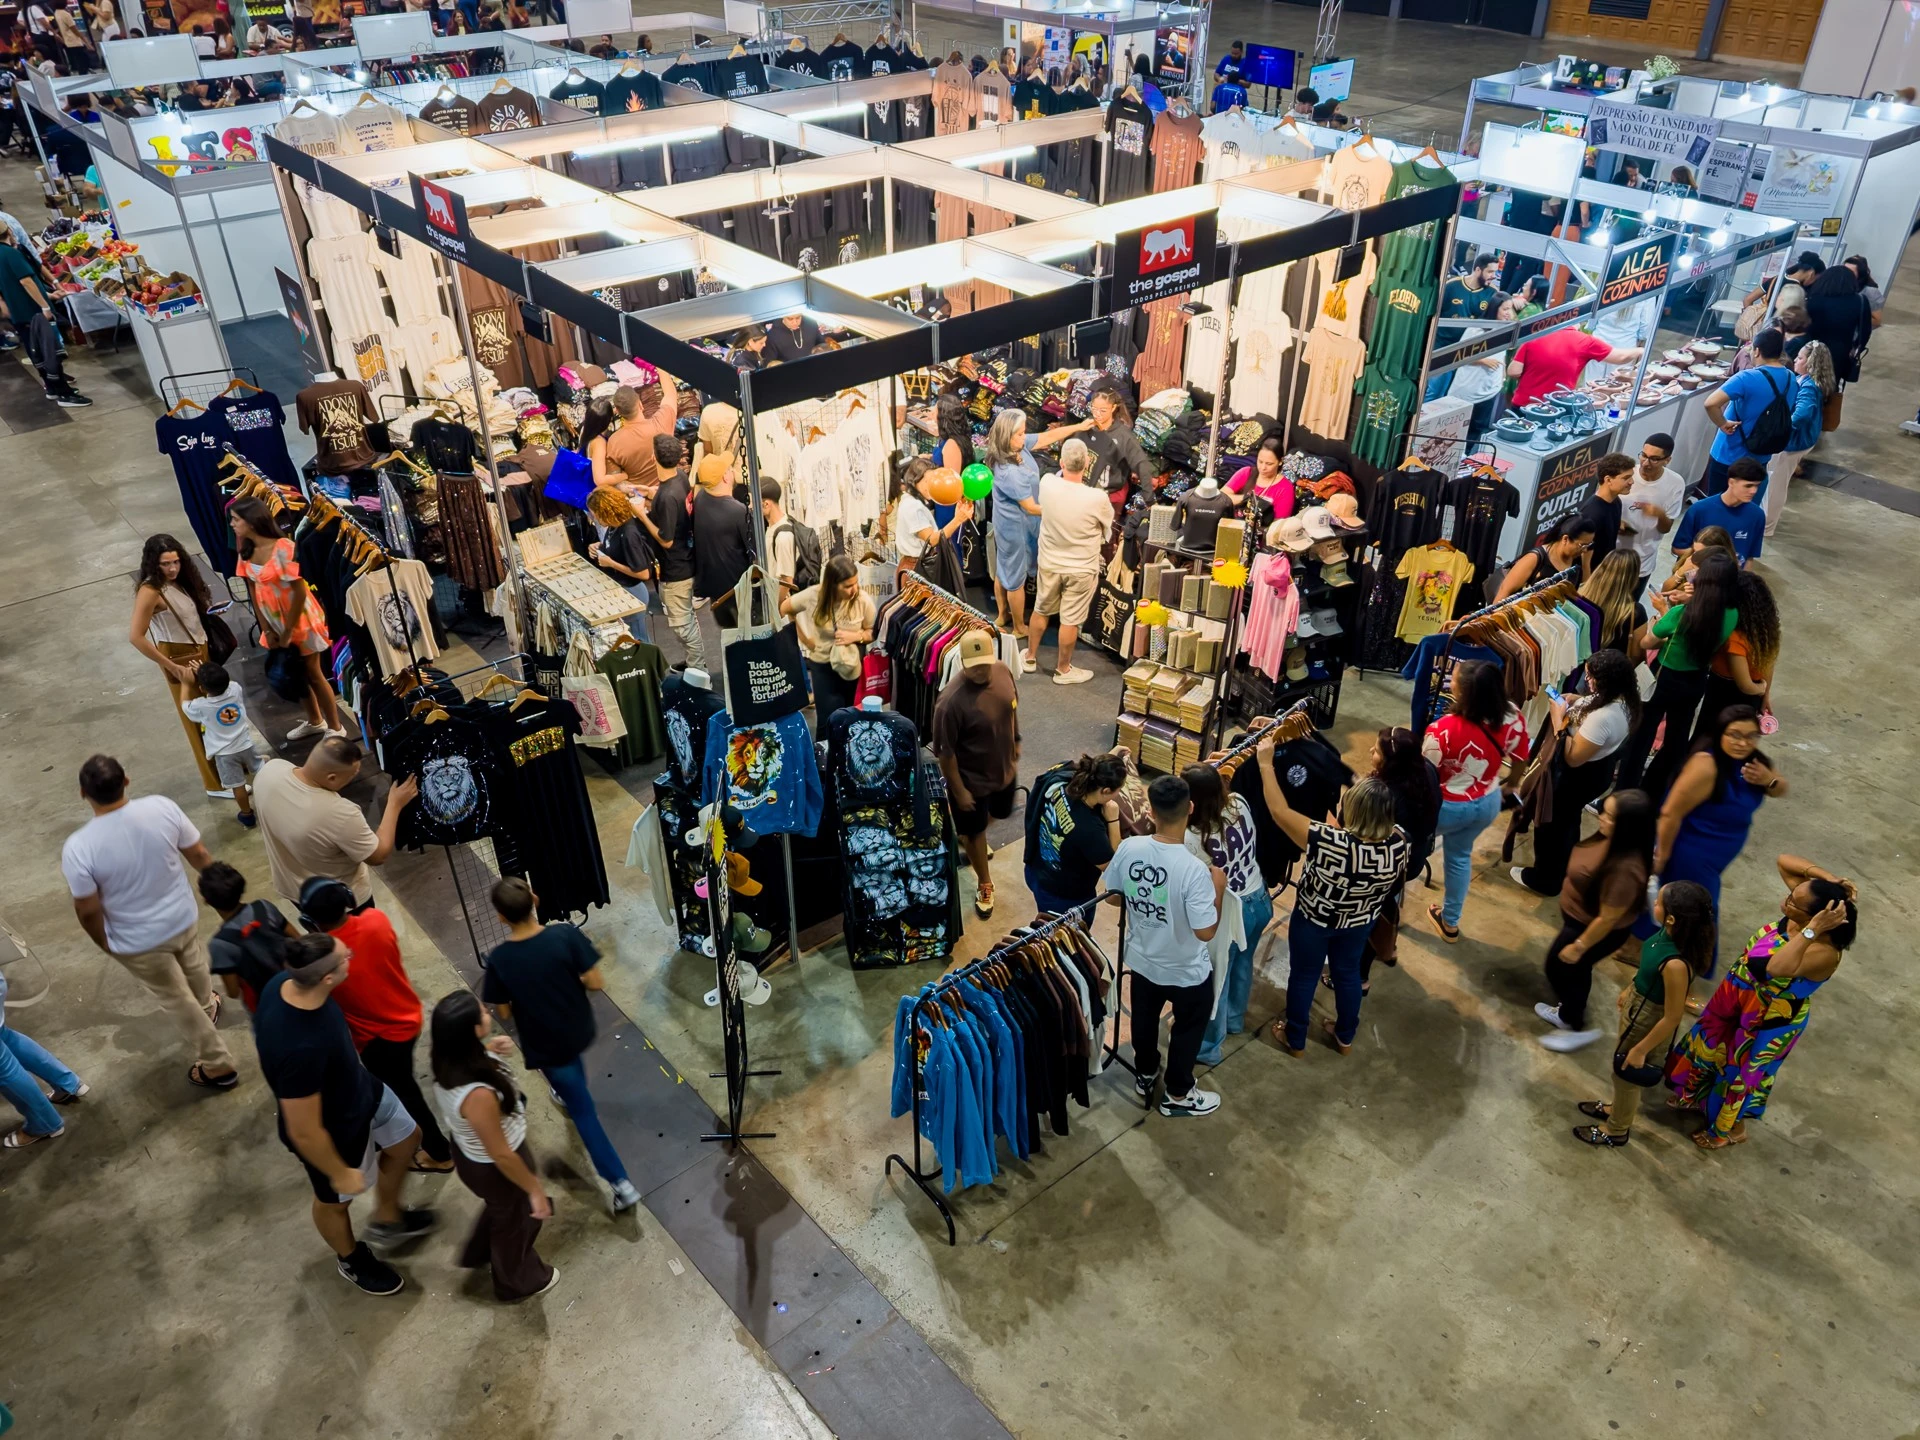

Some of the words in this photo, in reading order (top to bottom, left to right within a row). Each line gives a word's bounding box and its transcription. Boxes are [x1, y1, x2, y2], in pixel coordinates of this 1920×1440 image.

[1596, 105, 1650, 124] DEPRESSÃO
[1651, 115, 1659, 125] E
[1658, 117, 1713, 136] ANSIEDADE
[1610, 118, 1631, 133] NÃO
[1633, 123, 1689, 144] SIGNIFICAM
[1620, 134, 1646, 148] FALTA
[1647, 140, 1661, 151] DE
[1662, 142, 1677, 155] FÉ
[425, 223, 439, 240] the
[437, 233, 467, 254] gospel
[1750, 239, 1775, 256] ALFA
[1617, 244, 1661, 280] ALFA
[1128, 279, 1154, 295] the
[1154, 262, 1201, 290] gospel
[1601, 268, 1668, 305] COZINHAS
[1130, 294, 1154, 305] TODOS
[1155, 287, 1173, 299] PELO
[1174, 280, 1200, 293] REINO!
[1531, 307, 1579, 335] COZINHAS
[352, 334, 382, 356] SANTO
[1452, 340, 1489, 363] ALFA
[332, 436, 358, 450] TSURI
[1551, 446, 1592, 478] ALFA
[1538, 463, 1598, 500] COZINHAS
[1536, 482, 1590, 521] OUTLET
[1100, 586, 1129, 611] WANTED
[616, 667, 646, 682] Amém
[747, 660, 773, 670] Tudo
[748, 666, 781, 679] posso
[749, 670, 787, 686] naquele
[751, 685, 771, 695] que
[772, 679, 787, 691] me
[752, 683, 794, 701] fortalece.
[1128, 861, 1169, 889] GOD
[1126, 896, 1168, 925] HOPE
